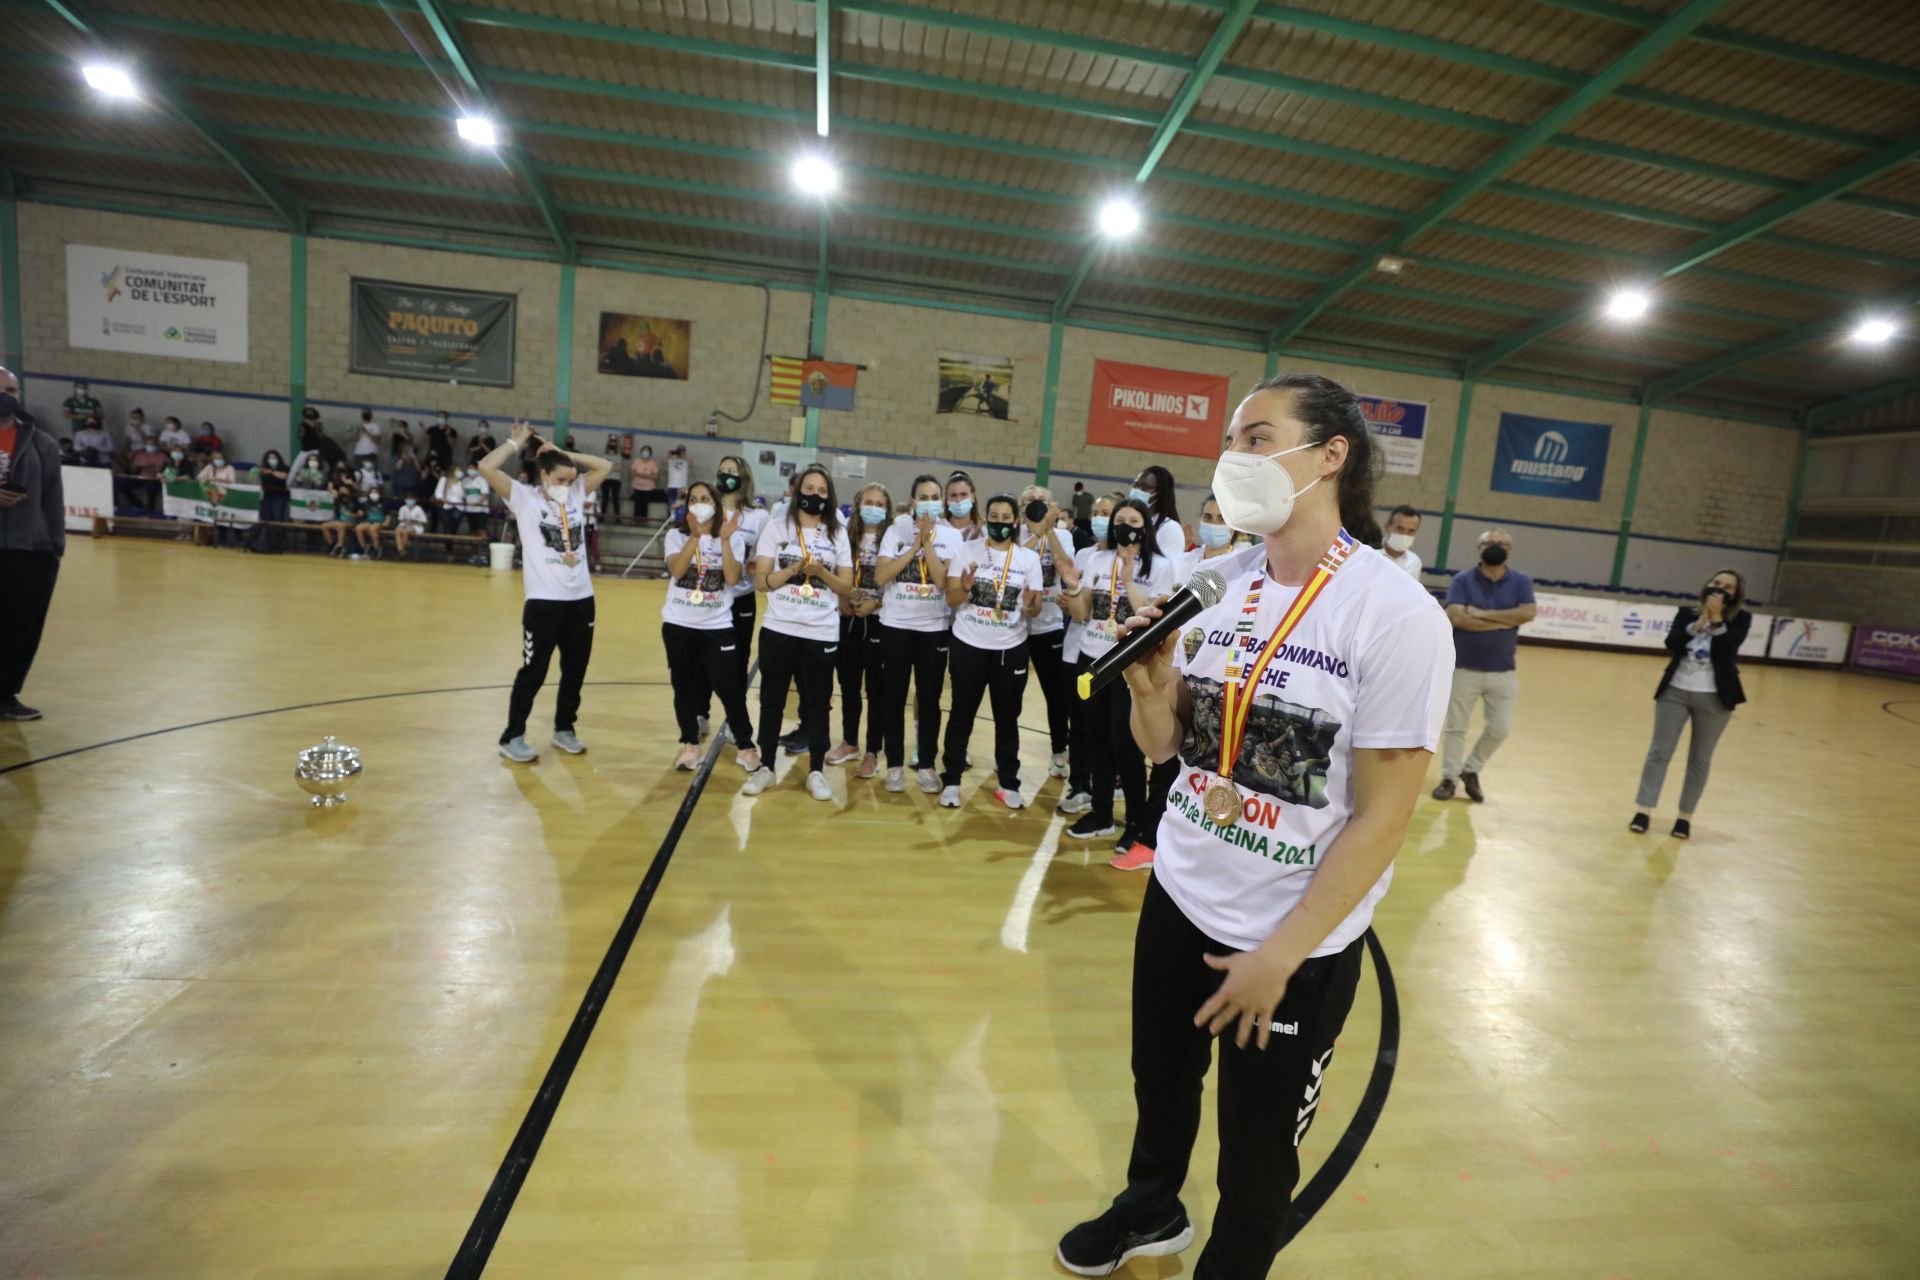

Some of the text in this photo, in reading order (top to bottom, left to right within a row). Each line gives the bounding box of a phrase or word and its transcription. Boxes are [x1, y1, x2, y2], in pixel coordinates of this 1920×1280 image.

[125, 276, 206, 294] COMUNITAT
[131, 289, 216, 307] DE L'ESPORT
[387, 311, 479, 337] PAQUITO
[1113, 387, 1184, 414] PIKOLINOS
[1510, 459, 1586, 482] mustang
[1207, 630, 1349, 679] CLU BAONMANO
[1242, 662, 1291, 689] ECHE
[1188, 773, 1281, 830] CAÓN
[1186, 801, 1199, 824] de
[1200, 810, 1212, 832] la
[1214, 823, 1268, 857] REINA
